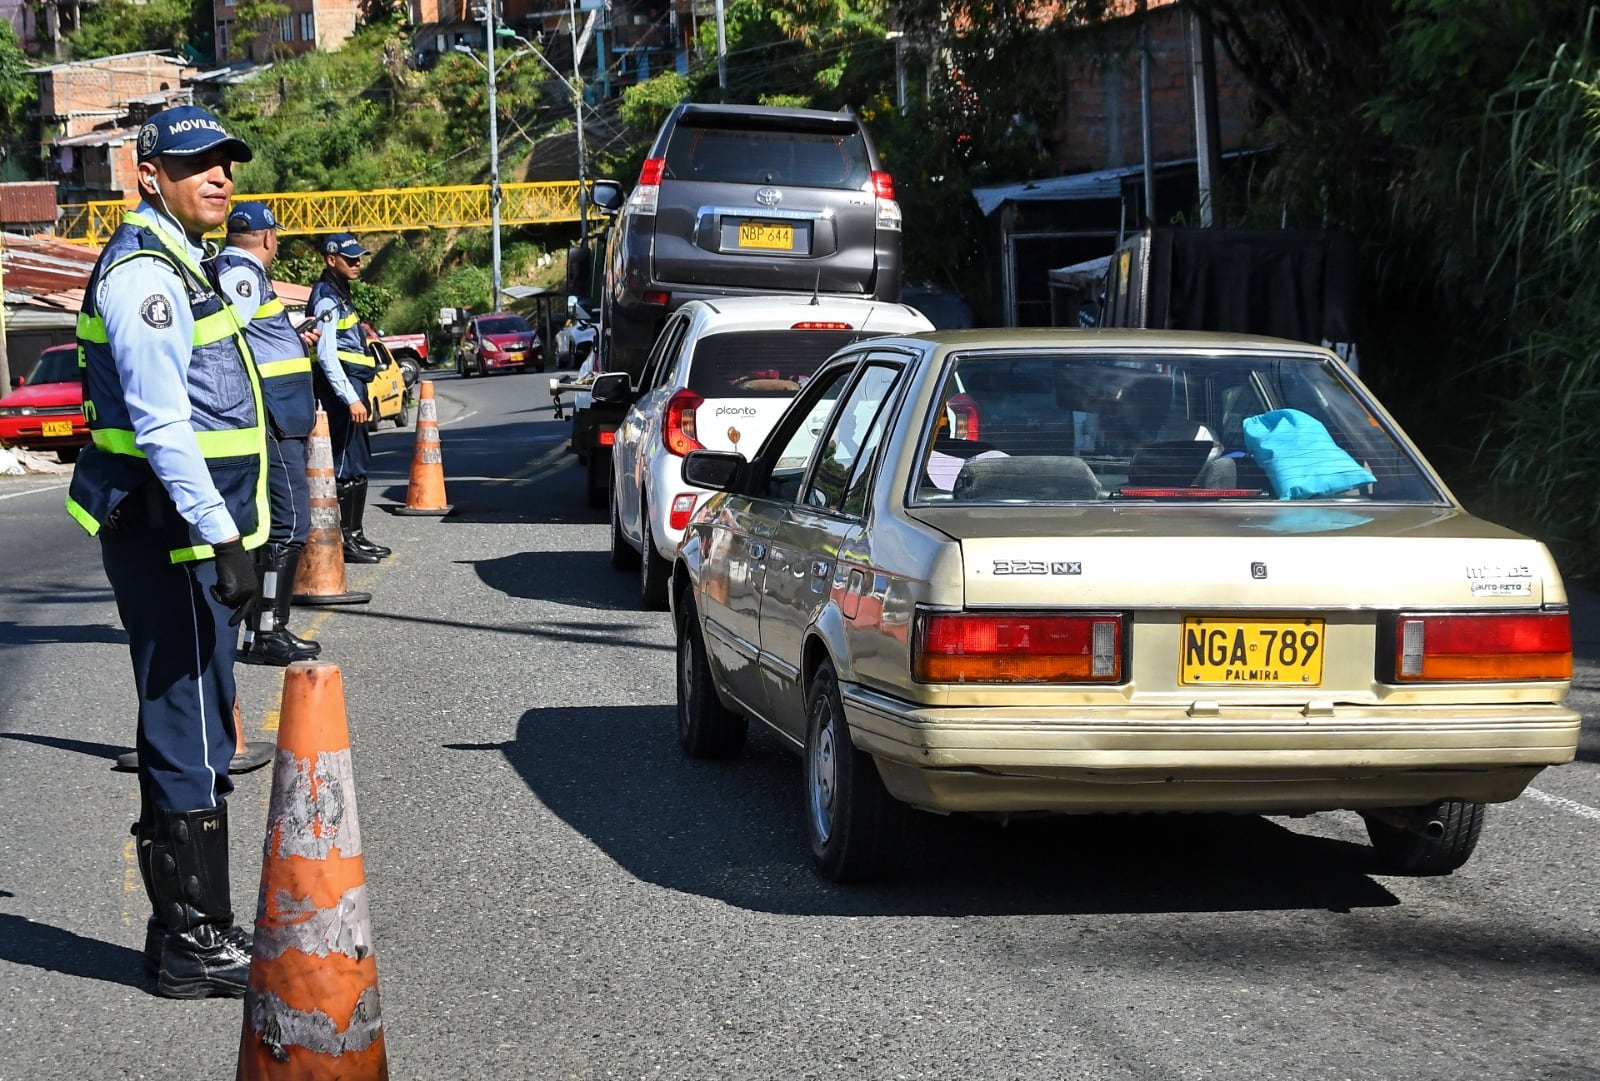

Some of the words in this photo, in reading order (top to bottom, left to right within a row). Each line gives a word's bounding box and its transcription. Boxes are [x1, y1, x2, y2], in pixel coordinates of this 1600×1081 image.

[742, 226, 765, 241] NBP
[767, 229, 789, 242] 644
[715, 405, 757, 417] picanto
[993, 560, 1048, 575] 323
[1053, 562, 1081, 575] NX
[1186, 628, 1248, 666] NGA
[1260, 629, 1319, 667] 789
[1225, 669, 1279, 681] PALMIRA
